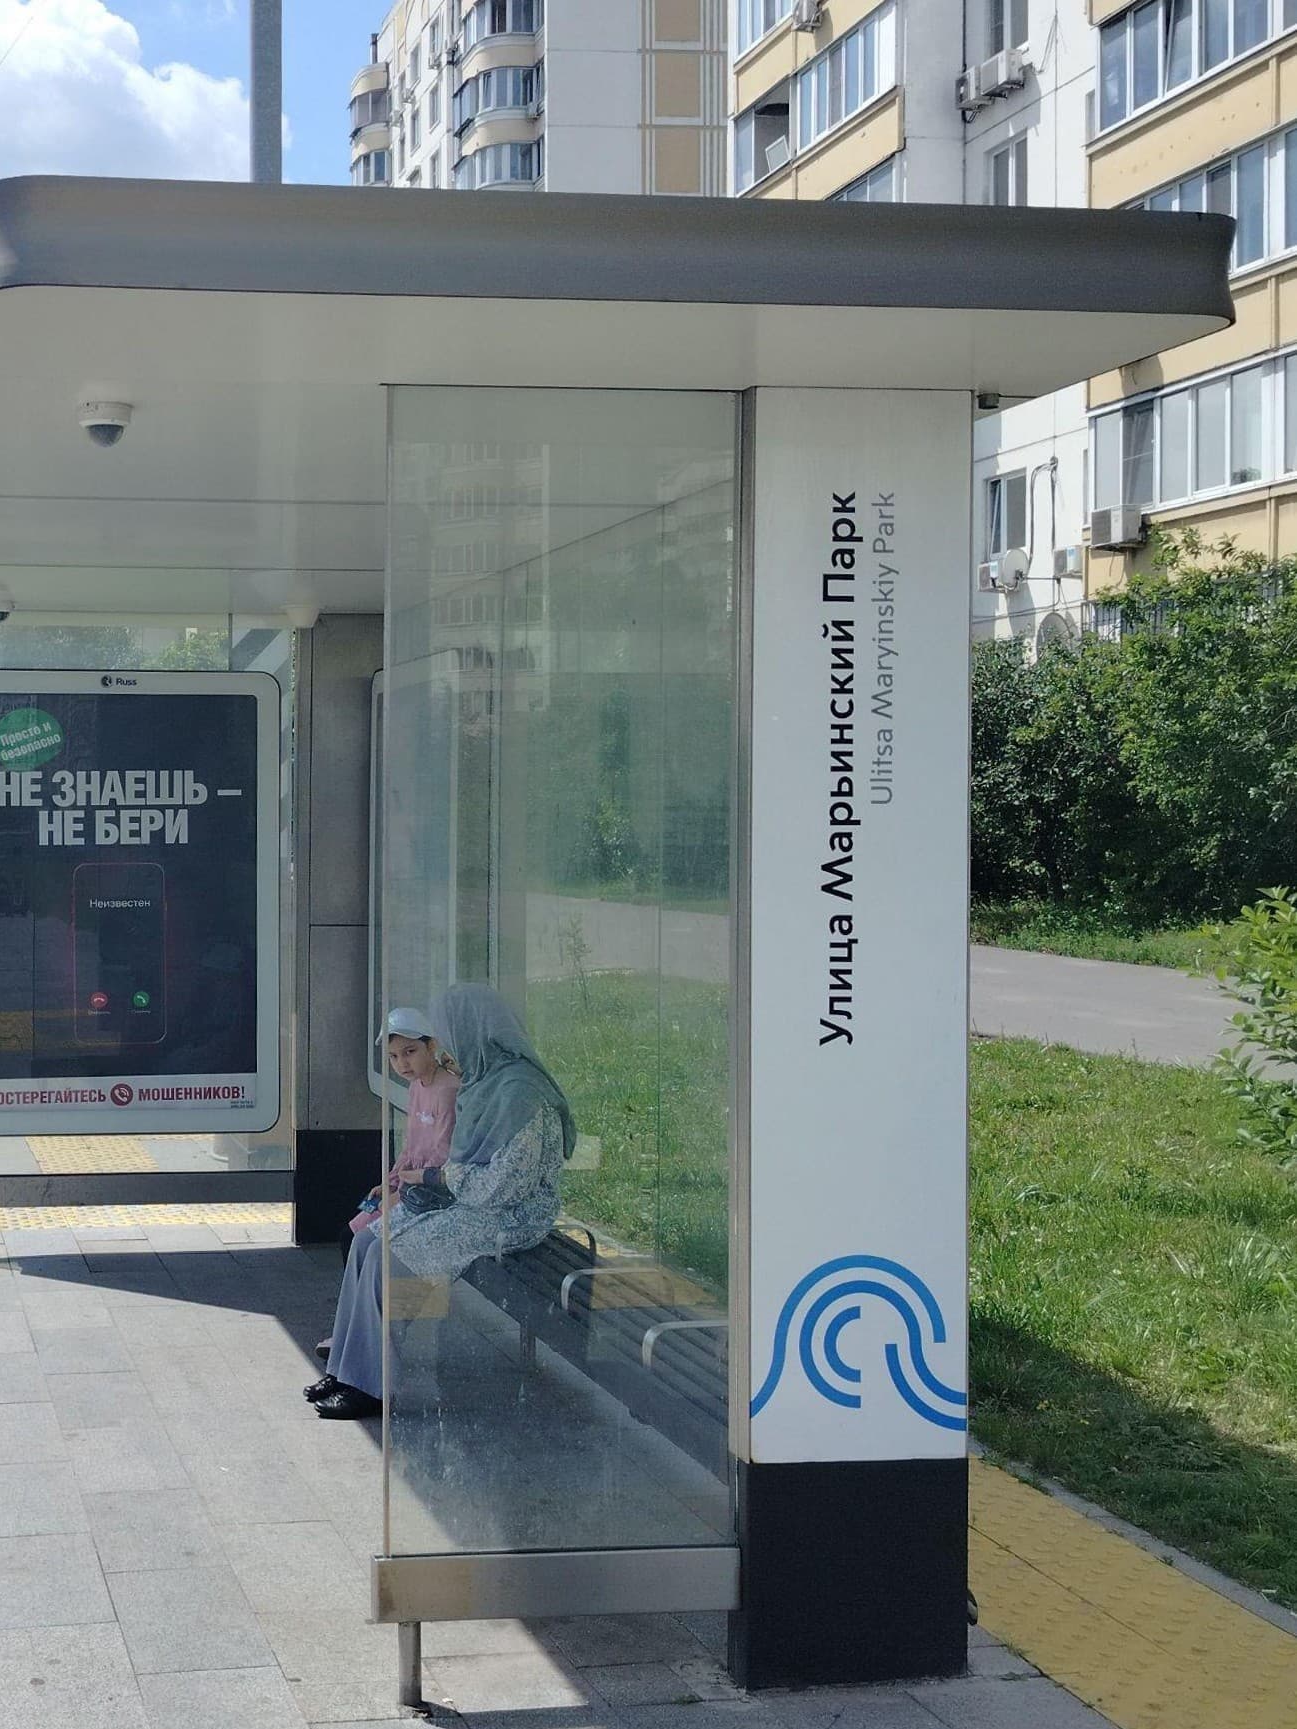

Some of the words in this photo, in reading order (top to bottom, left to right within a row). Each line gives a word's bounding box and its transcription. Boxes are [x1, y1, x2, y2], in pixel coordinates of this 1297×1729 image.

[870, 491, 895, 553] Park
[822, 491, 863, 602] Парк
[870, 563, 899, 720] Maryinskiy
[115, 677, 137, 686] Russ
[0, 726, 41, 747] Просто
[0, 734, 61, 761] безопасно
[821, 619, 861, 902] Марьинский
[869, 728, 894, 804] Ulitsa
[51, 769, 208, 808] ЗНАЕШЬ
[38, 810, 85, 846] НЕ
[95, 808, 189, 845] БЕРИ
[89, 898, 151, 909] Неизвестен
[819, 914, 859, 1047] Улица
[137, 1085, 246, 1102] МОШЕННИКОВ!
